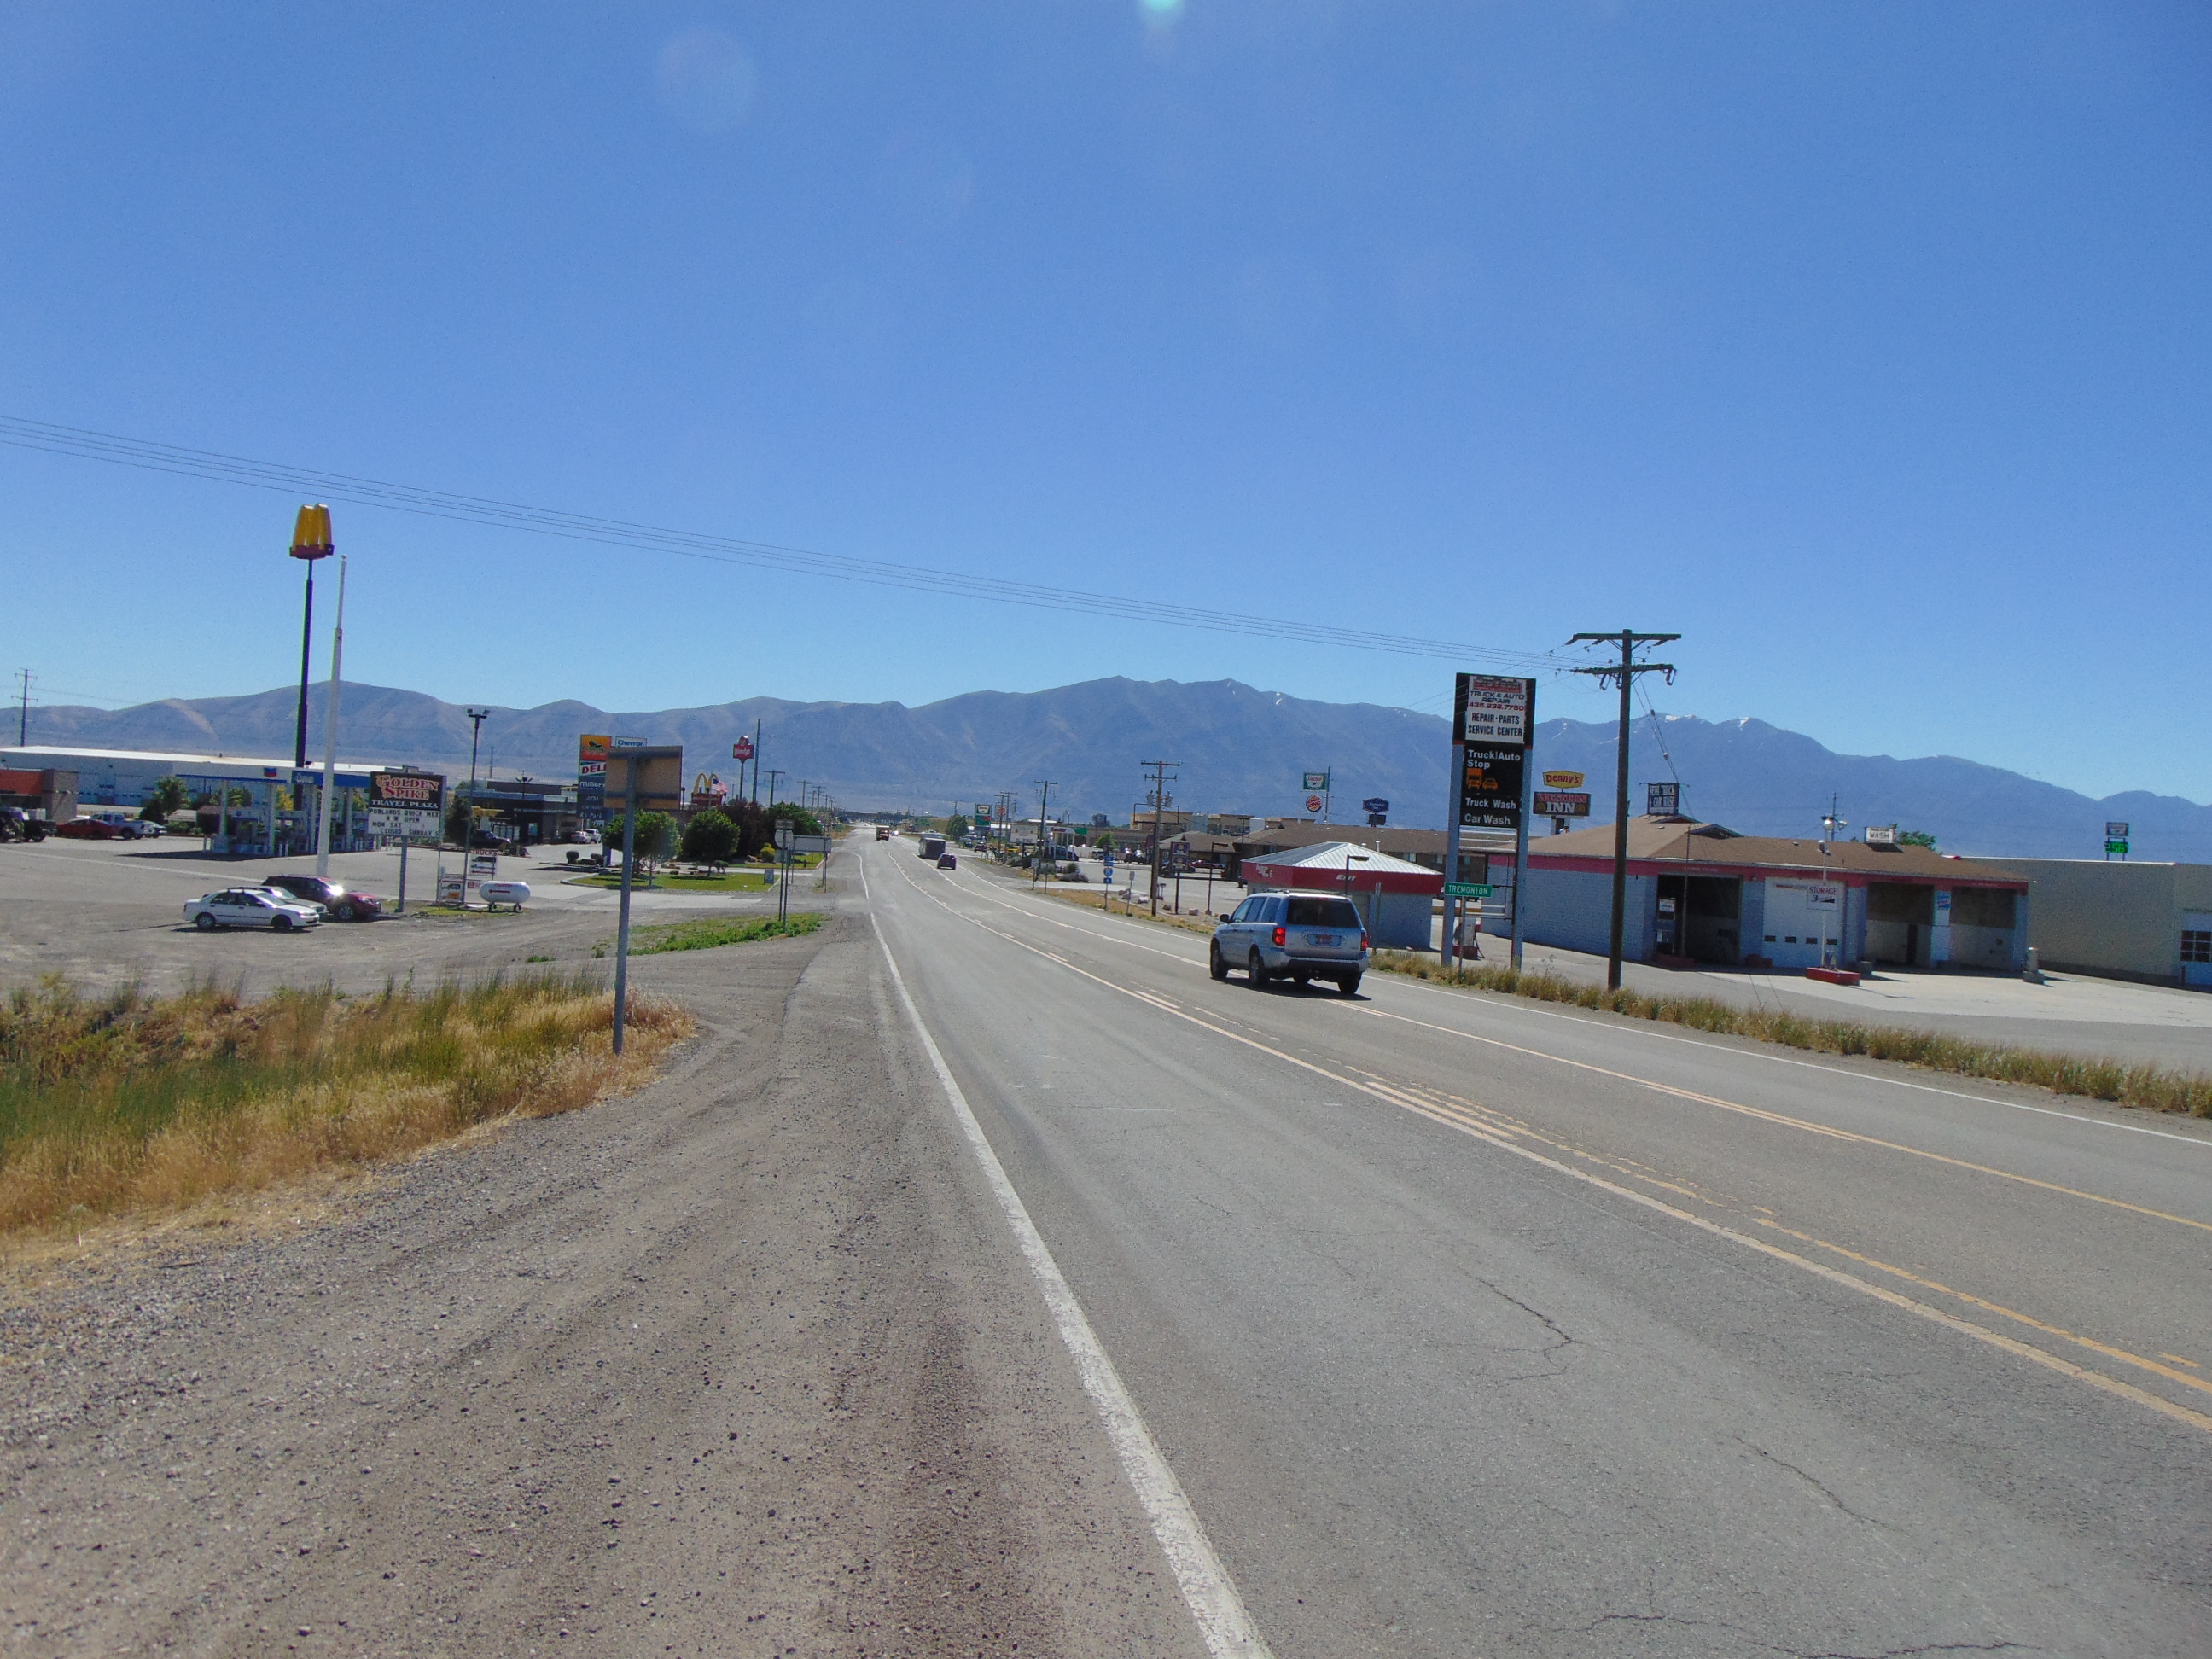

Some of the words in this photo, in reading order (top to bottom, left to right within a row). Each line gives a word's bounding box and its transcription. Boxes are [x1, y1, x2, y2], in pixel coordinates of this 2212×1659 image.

[1471, 713, 1494, 723] REPAIR
[1499, 715, 1520, 725] PARTS
[1468, 725, 1494, 735] SERVICE
[1498, 727, 1522, 737] CENTER
[1467, 759, 1491, 770] Stop
[376, 775, 439, 791] GOLDEN
[1545, 774, 1580, 783] Denny's
[384, 787, 430, 800] SPIKE
[1464, 798, 1489, 807] Truck
[1493, 799, 1516, 809] Wash
[1545, 801, 1576, 813] INN
[1464, 814, 1482, 824] Car
[1483, 815, 1511, 825] Wash
[1448, 885, 1488, 895] TREMONTON
[1808, 887, 1837, 895] STORAGE
